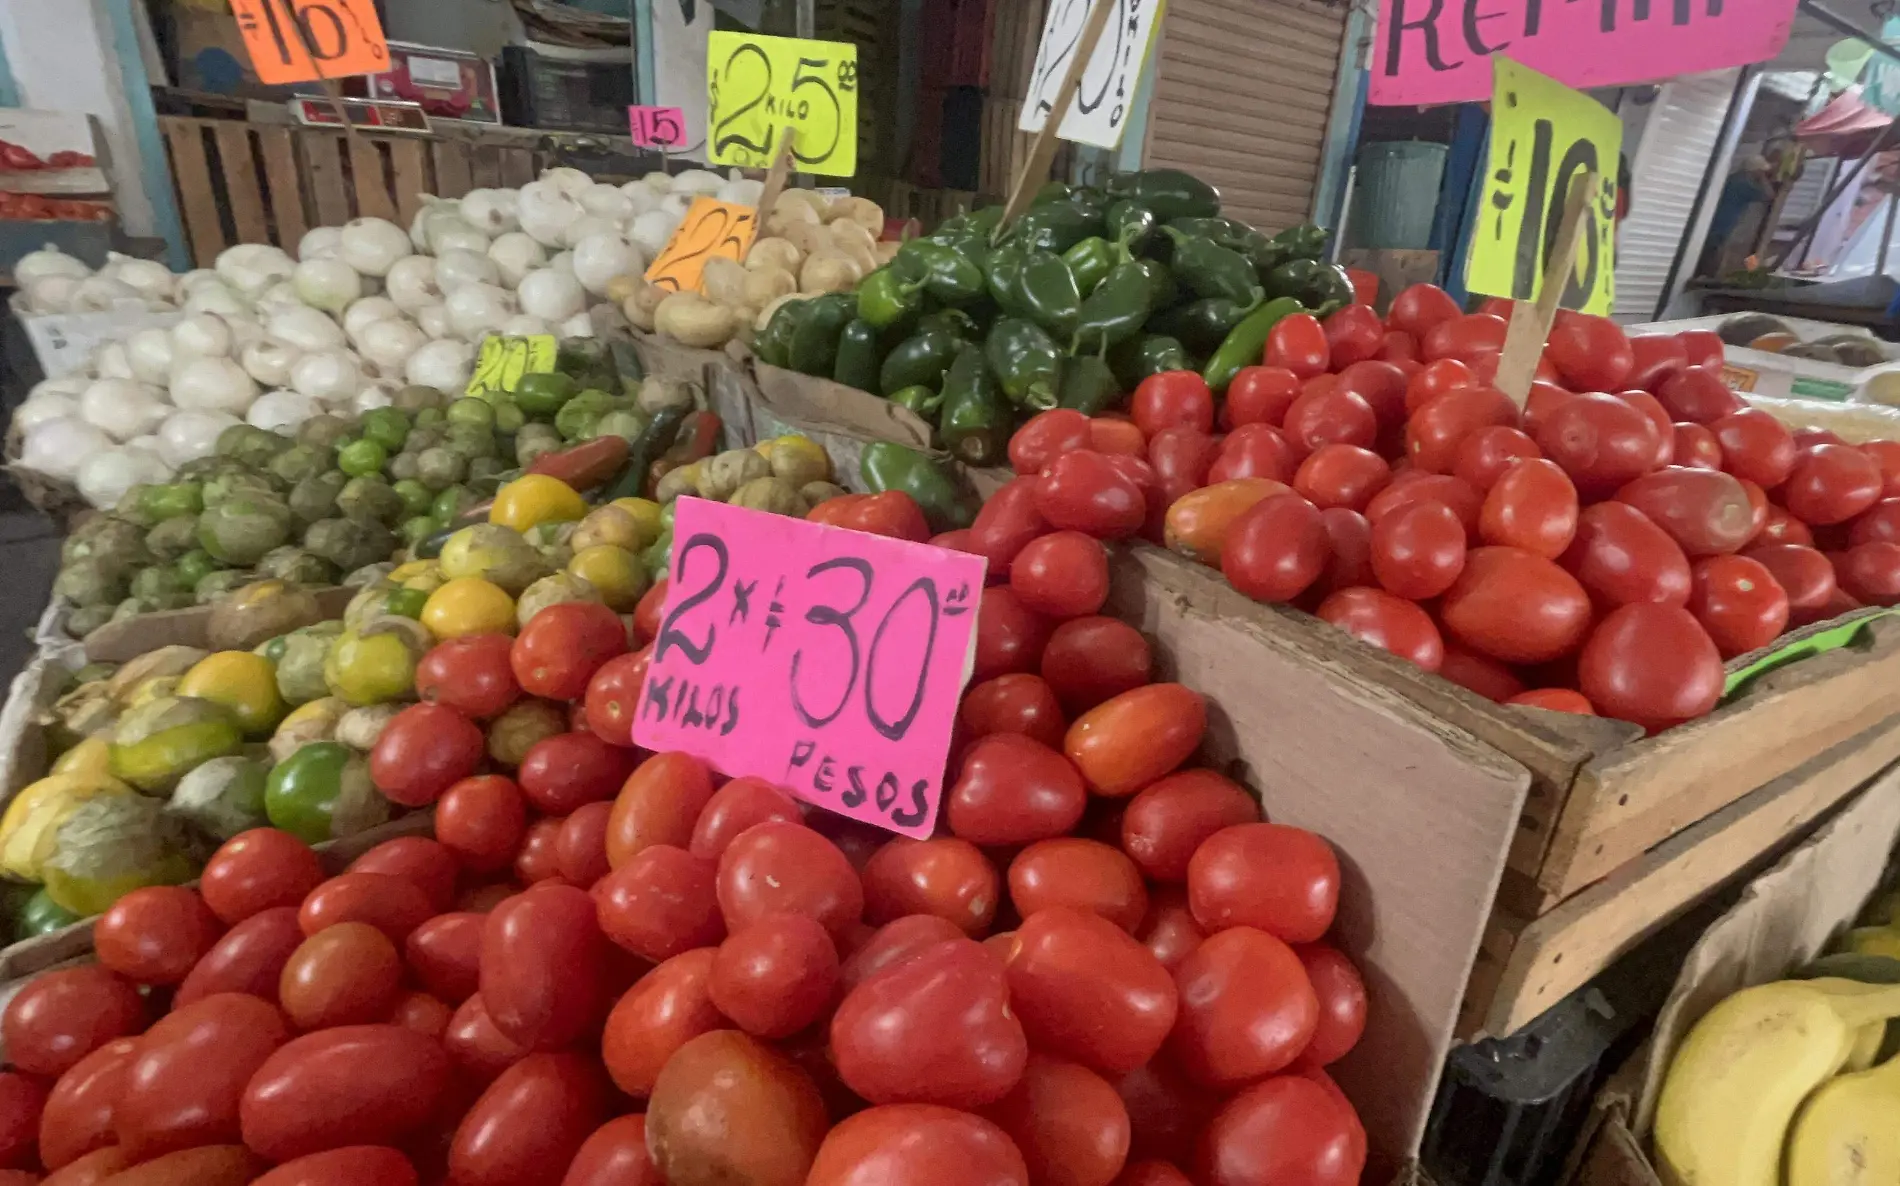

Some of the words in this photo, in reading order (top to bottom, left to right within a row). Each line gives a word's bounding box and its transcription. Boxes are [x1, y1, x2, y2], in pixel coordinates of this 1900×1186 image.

[765, 93, 810, 121] KILO
[654, 532, 729, 666] 2
[642, 675, 741, 737] KILOS
[784, 740, 930, 828] PESOS
